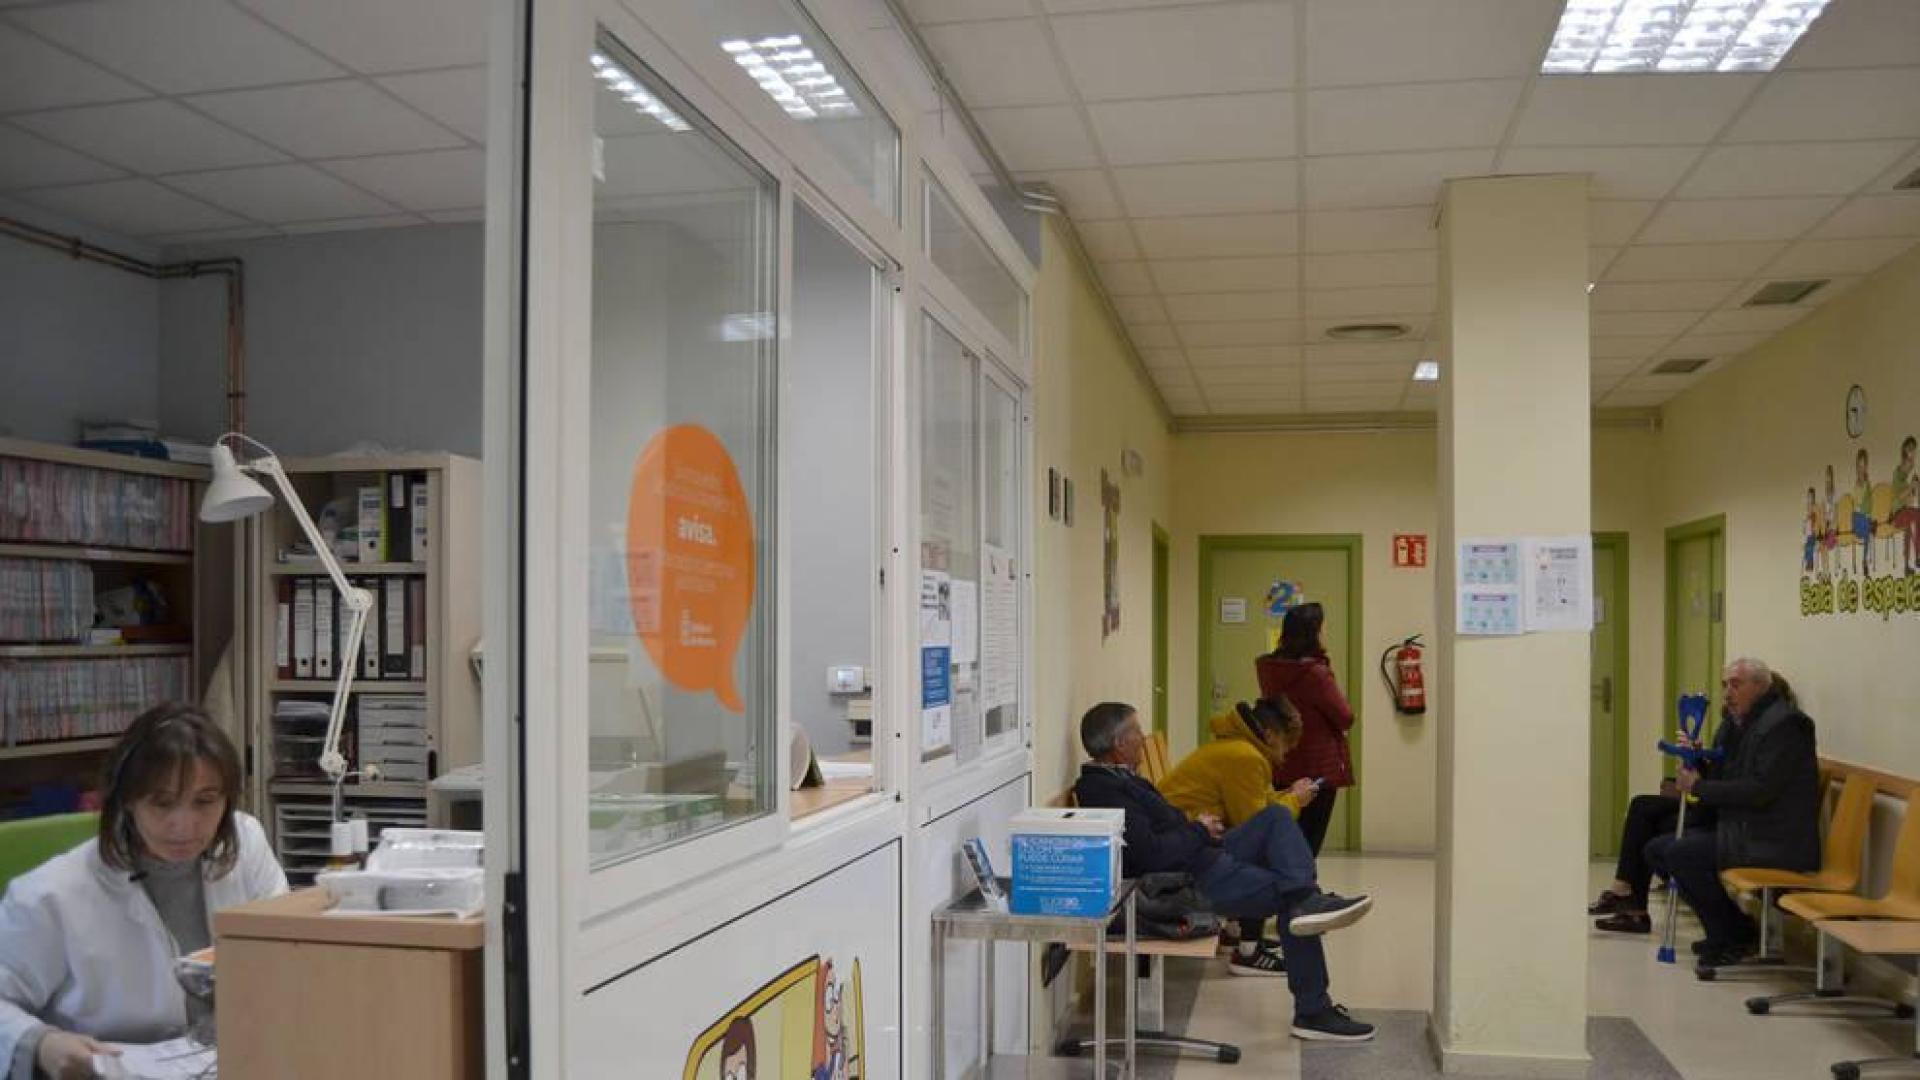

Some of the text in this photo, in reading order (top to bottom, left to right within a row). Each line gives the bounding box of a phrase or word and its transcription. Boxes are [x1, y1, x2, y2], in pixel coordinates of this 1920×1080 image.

[1270, 580, 1296, 615] 2
[1801, 572, 1832, 616] Sala
[1839, 568, 1858, 613] de
